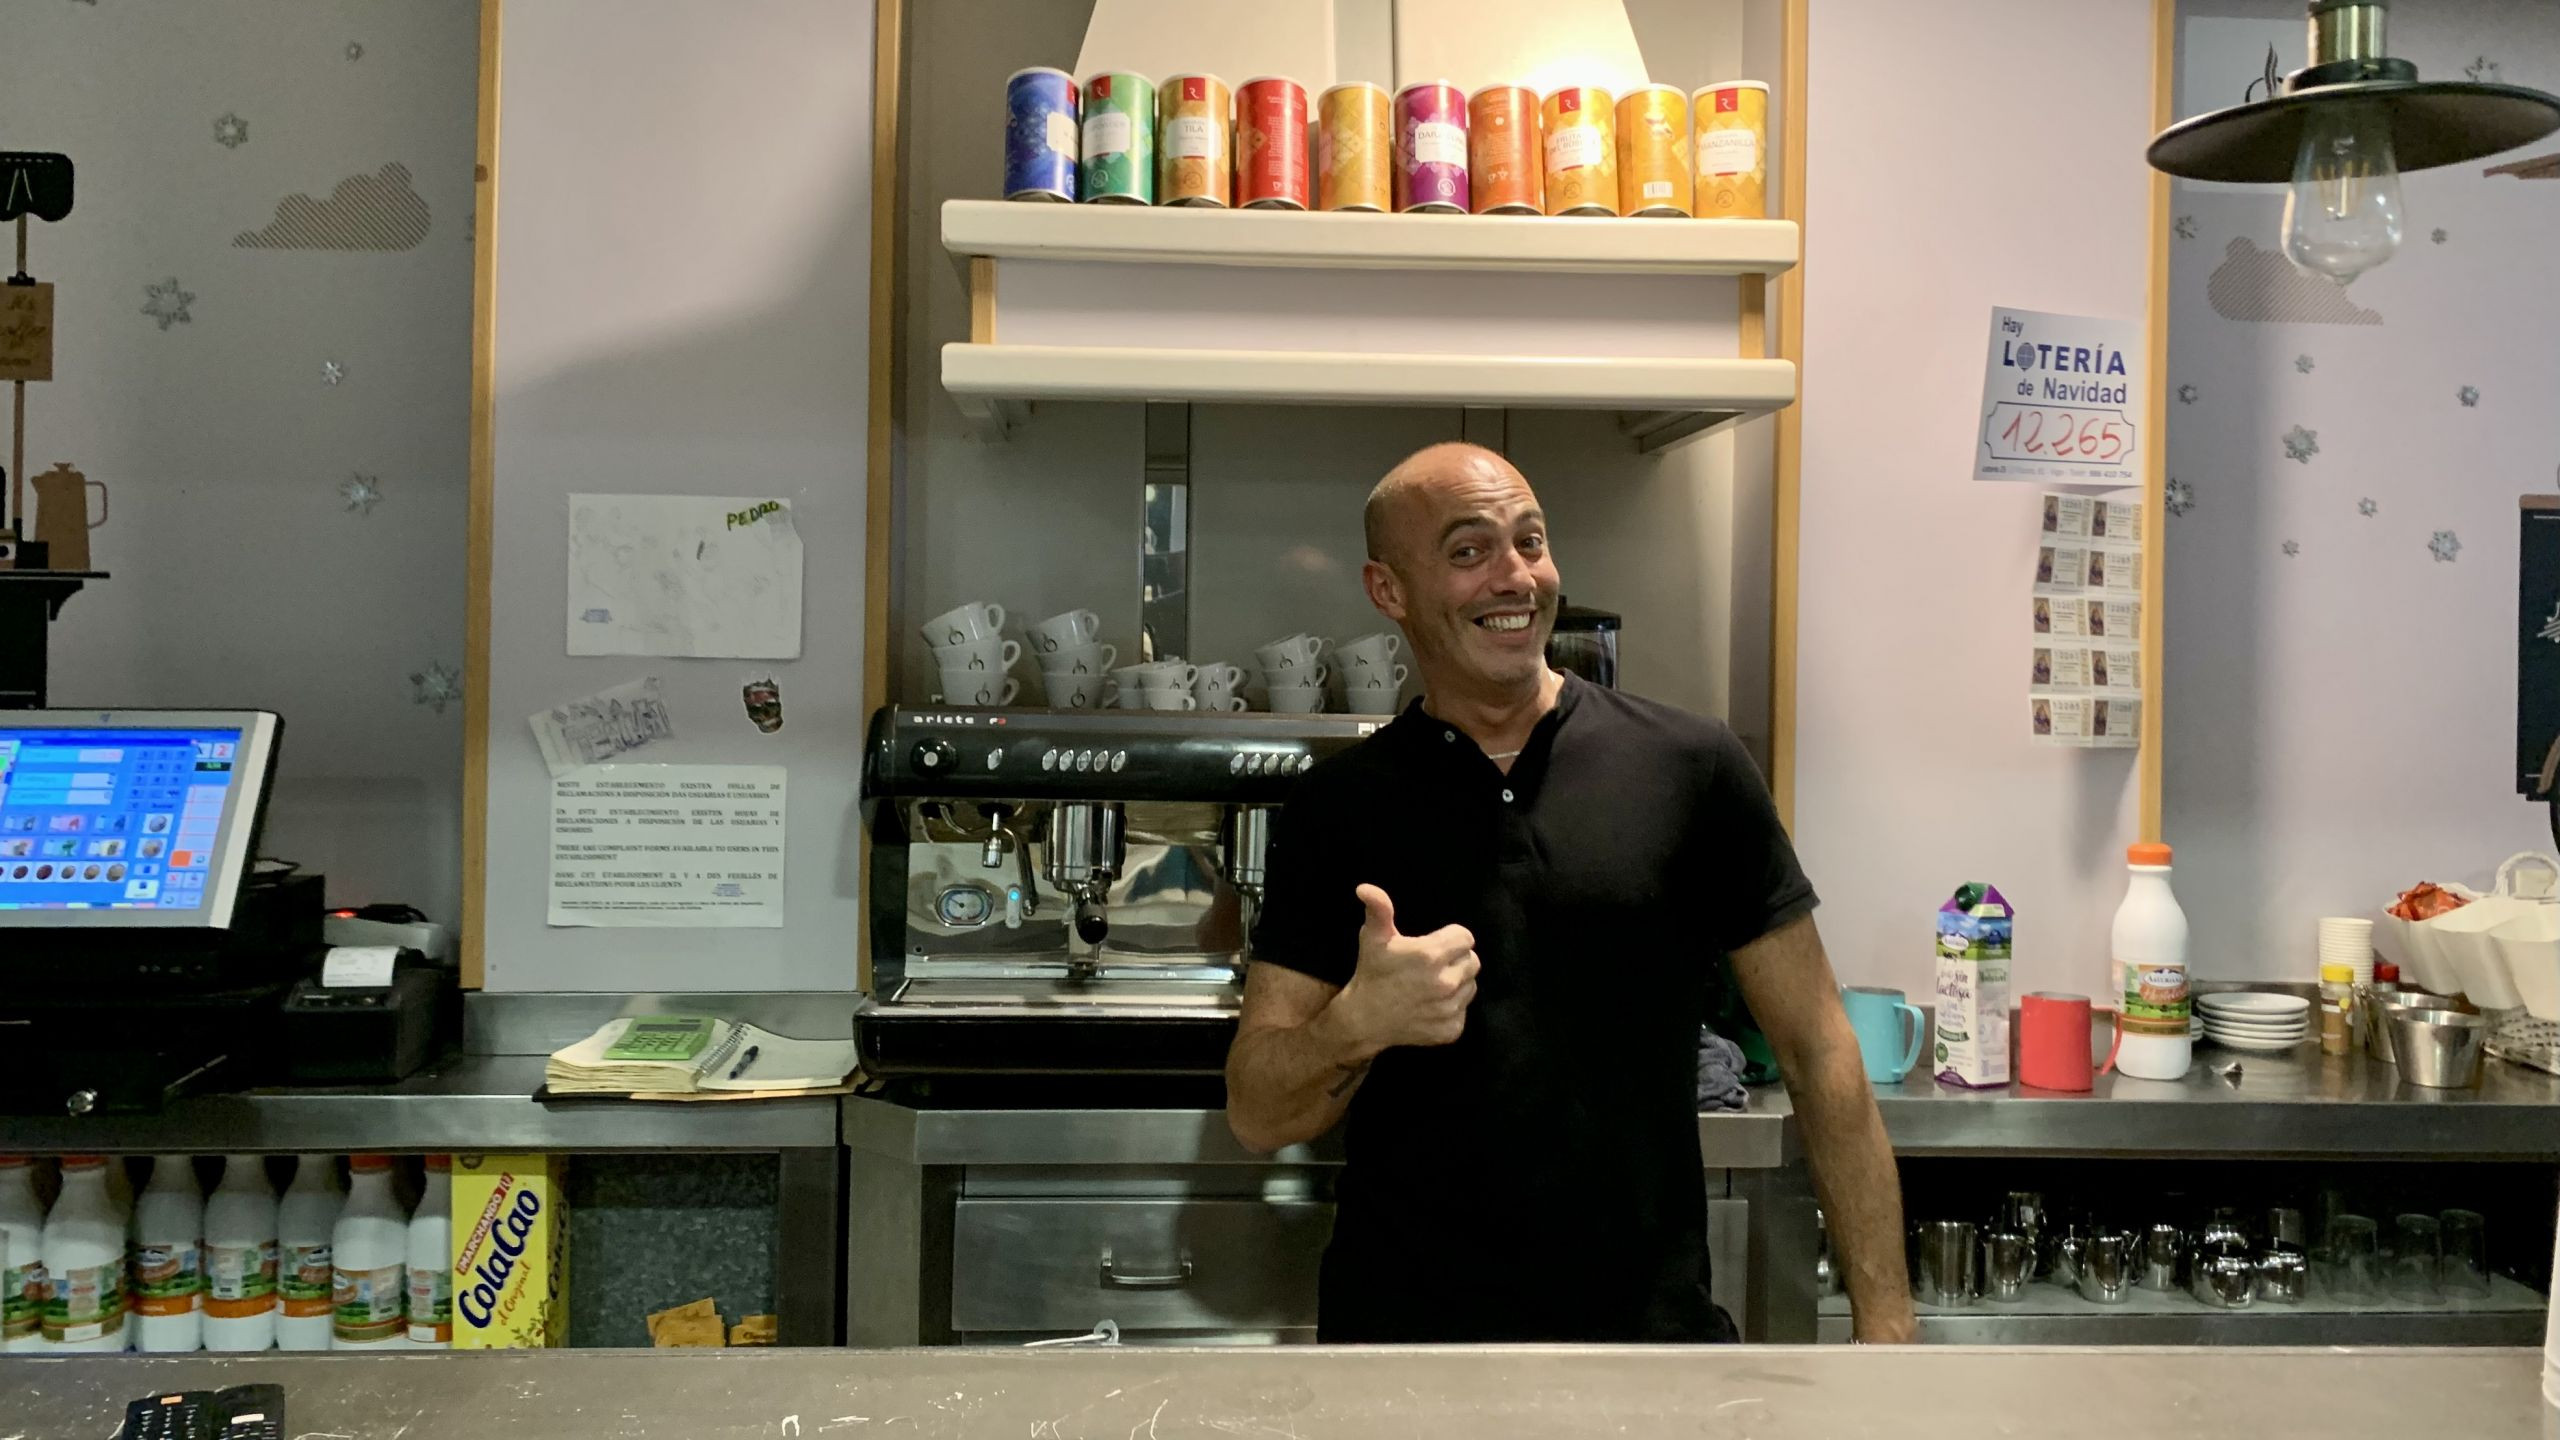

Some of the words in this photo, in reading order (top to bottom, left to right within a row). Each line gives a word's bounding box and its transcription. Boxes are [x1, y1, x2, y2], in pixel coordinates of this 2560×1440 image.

[1184, 125, 1204, 133] TILA
[2001, 316, 2024, 338] Hay
[2002, 340, 2127, 376] LOTERÍA
[2017, 378, 2034, 396] de
[2043, 377, 2127, 404] Navidad
[726, 500, 780, 531] PEDRO
[458, 1189, 540, 1329] ColaCao
